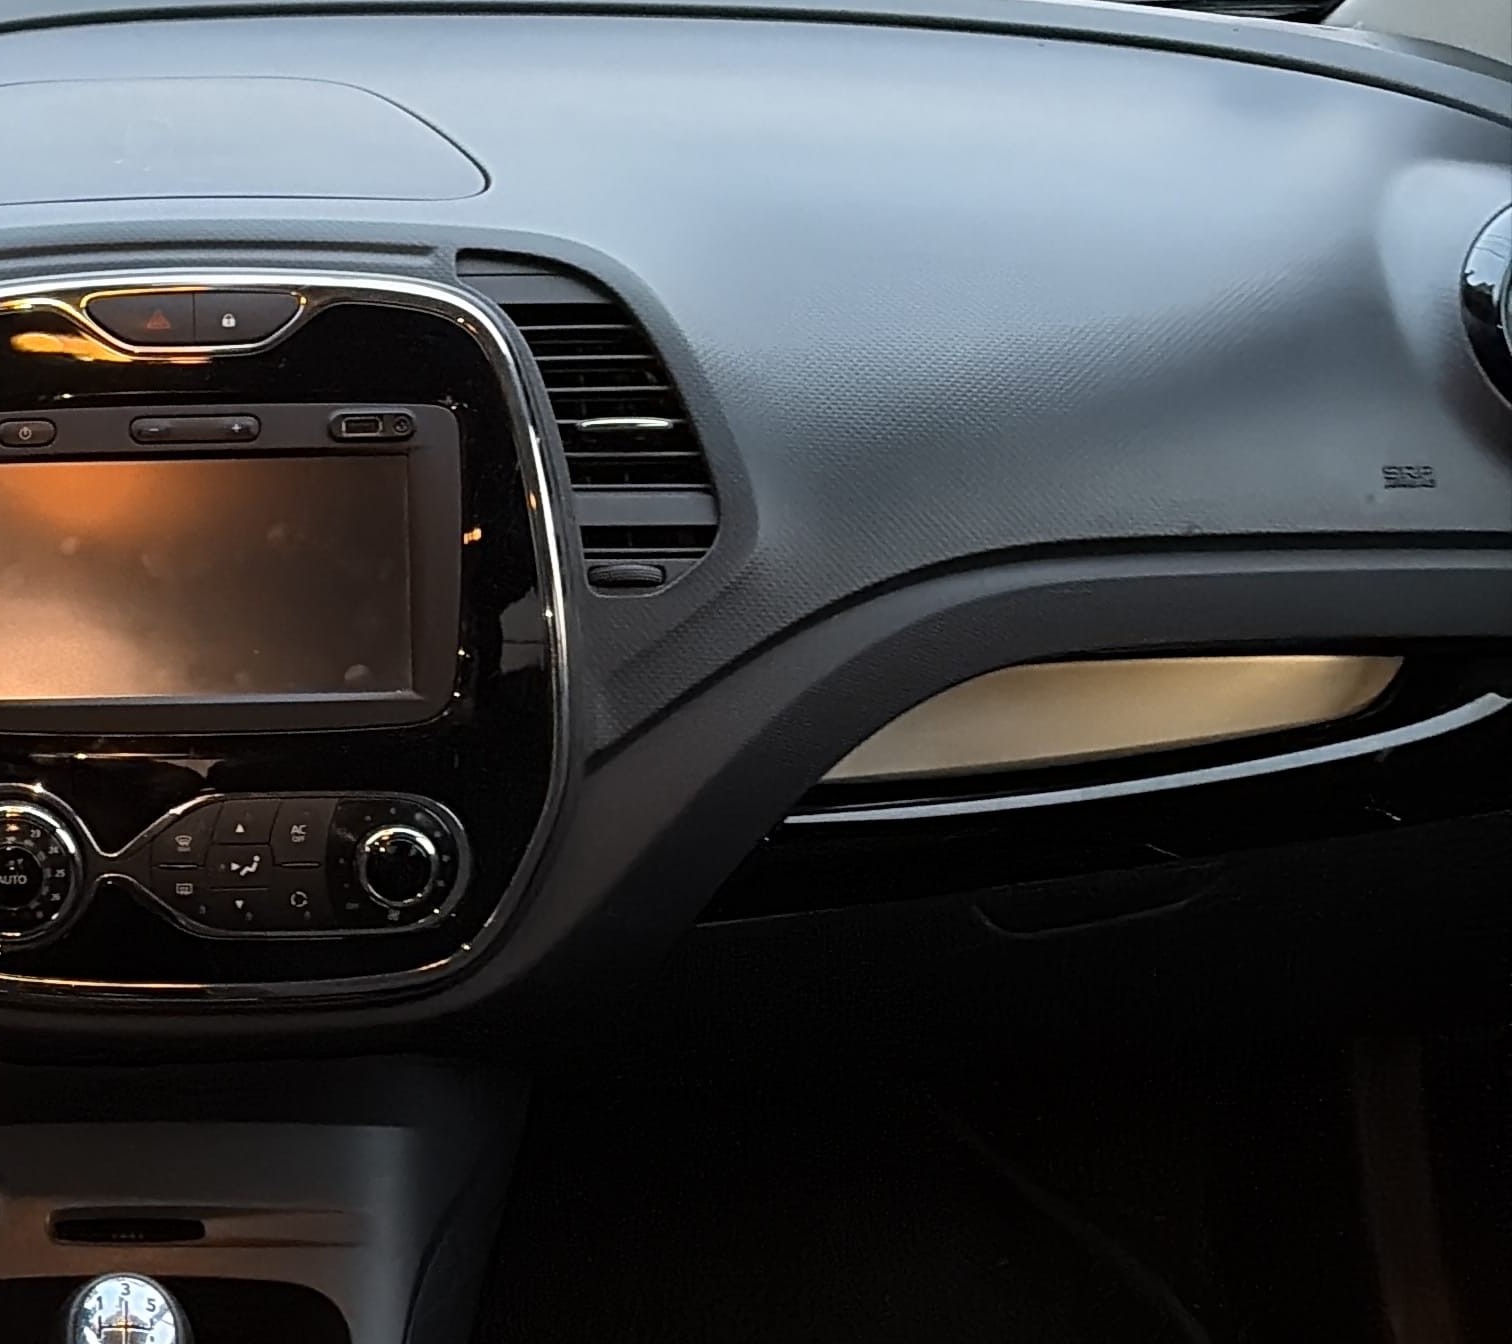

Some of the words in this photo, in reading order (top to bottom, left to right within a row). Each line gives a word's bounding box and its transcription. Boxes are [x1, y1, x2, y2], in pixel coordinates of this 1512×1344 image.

[290, 824, 307, 835] AC
[121, 1283, 131, 1296] 3
[146, 1298, 156, 1312] 5
